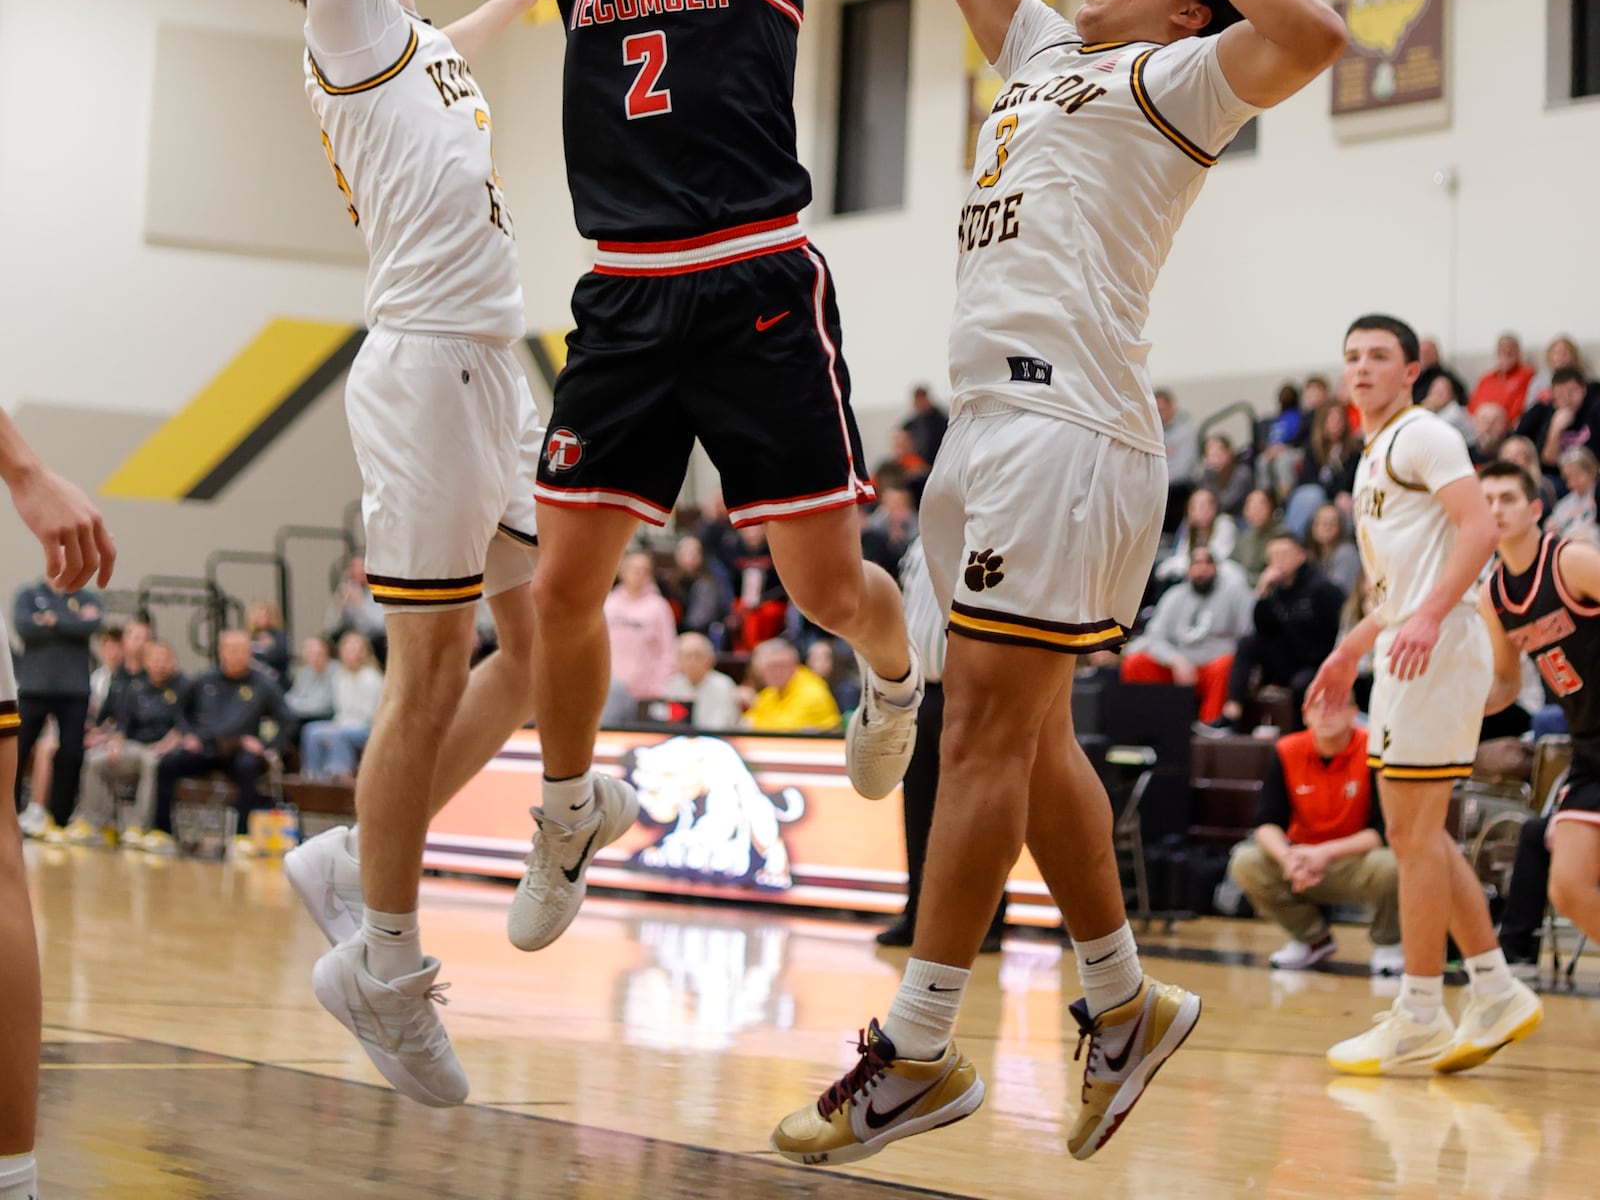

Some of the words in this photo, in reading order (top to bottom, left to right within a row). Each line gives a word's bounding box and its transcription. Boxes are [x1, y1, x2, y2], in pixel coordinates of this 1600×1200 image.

[622, 30, 672, 120] 2
[977, 114, 1018, 189] 3
[1536, 646, 1584, 697] 15
